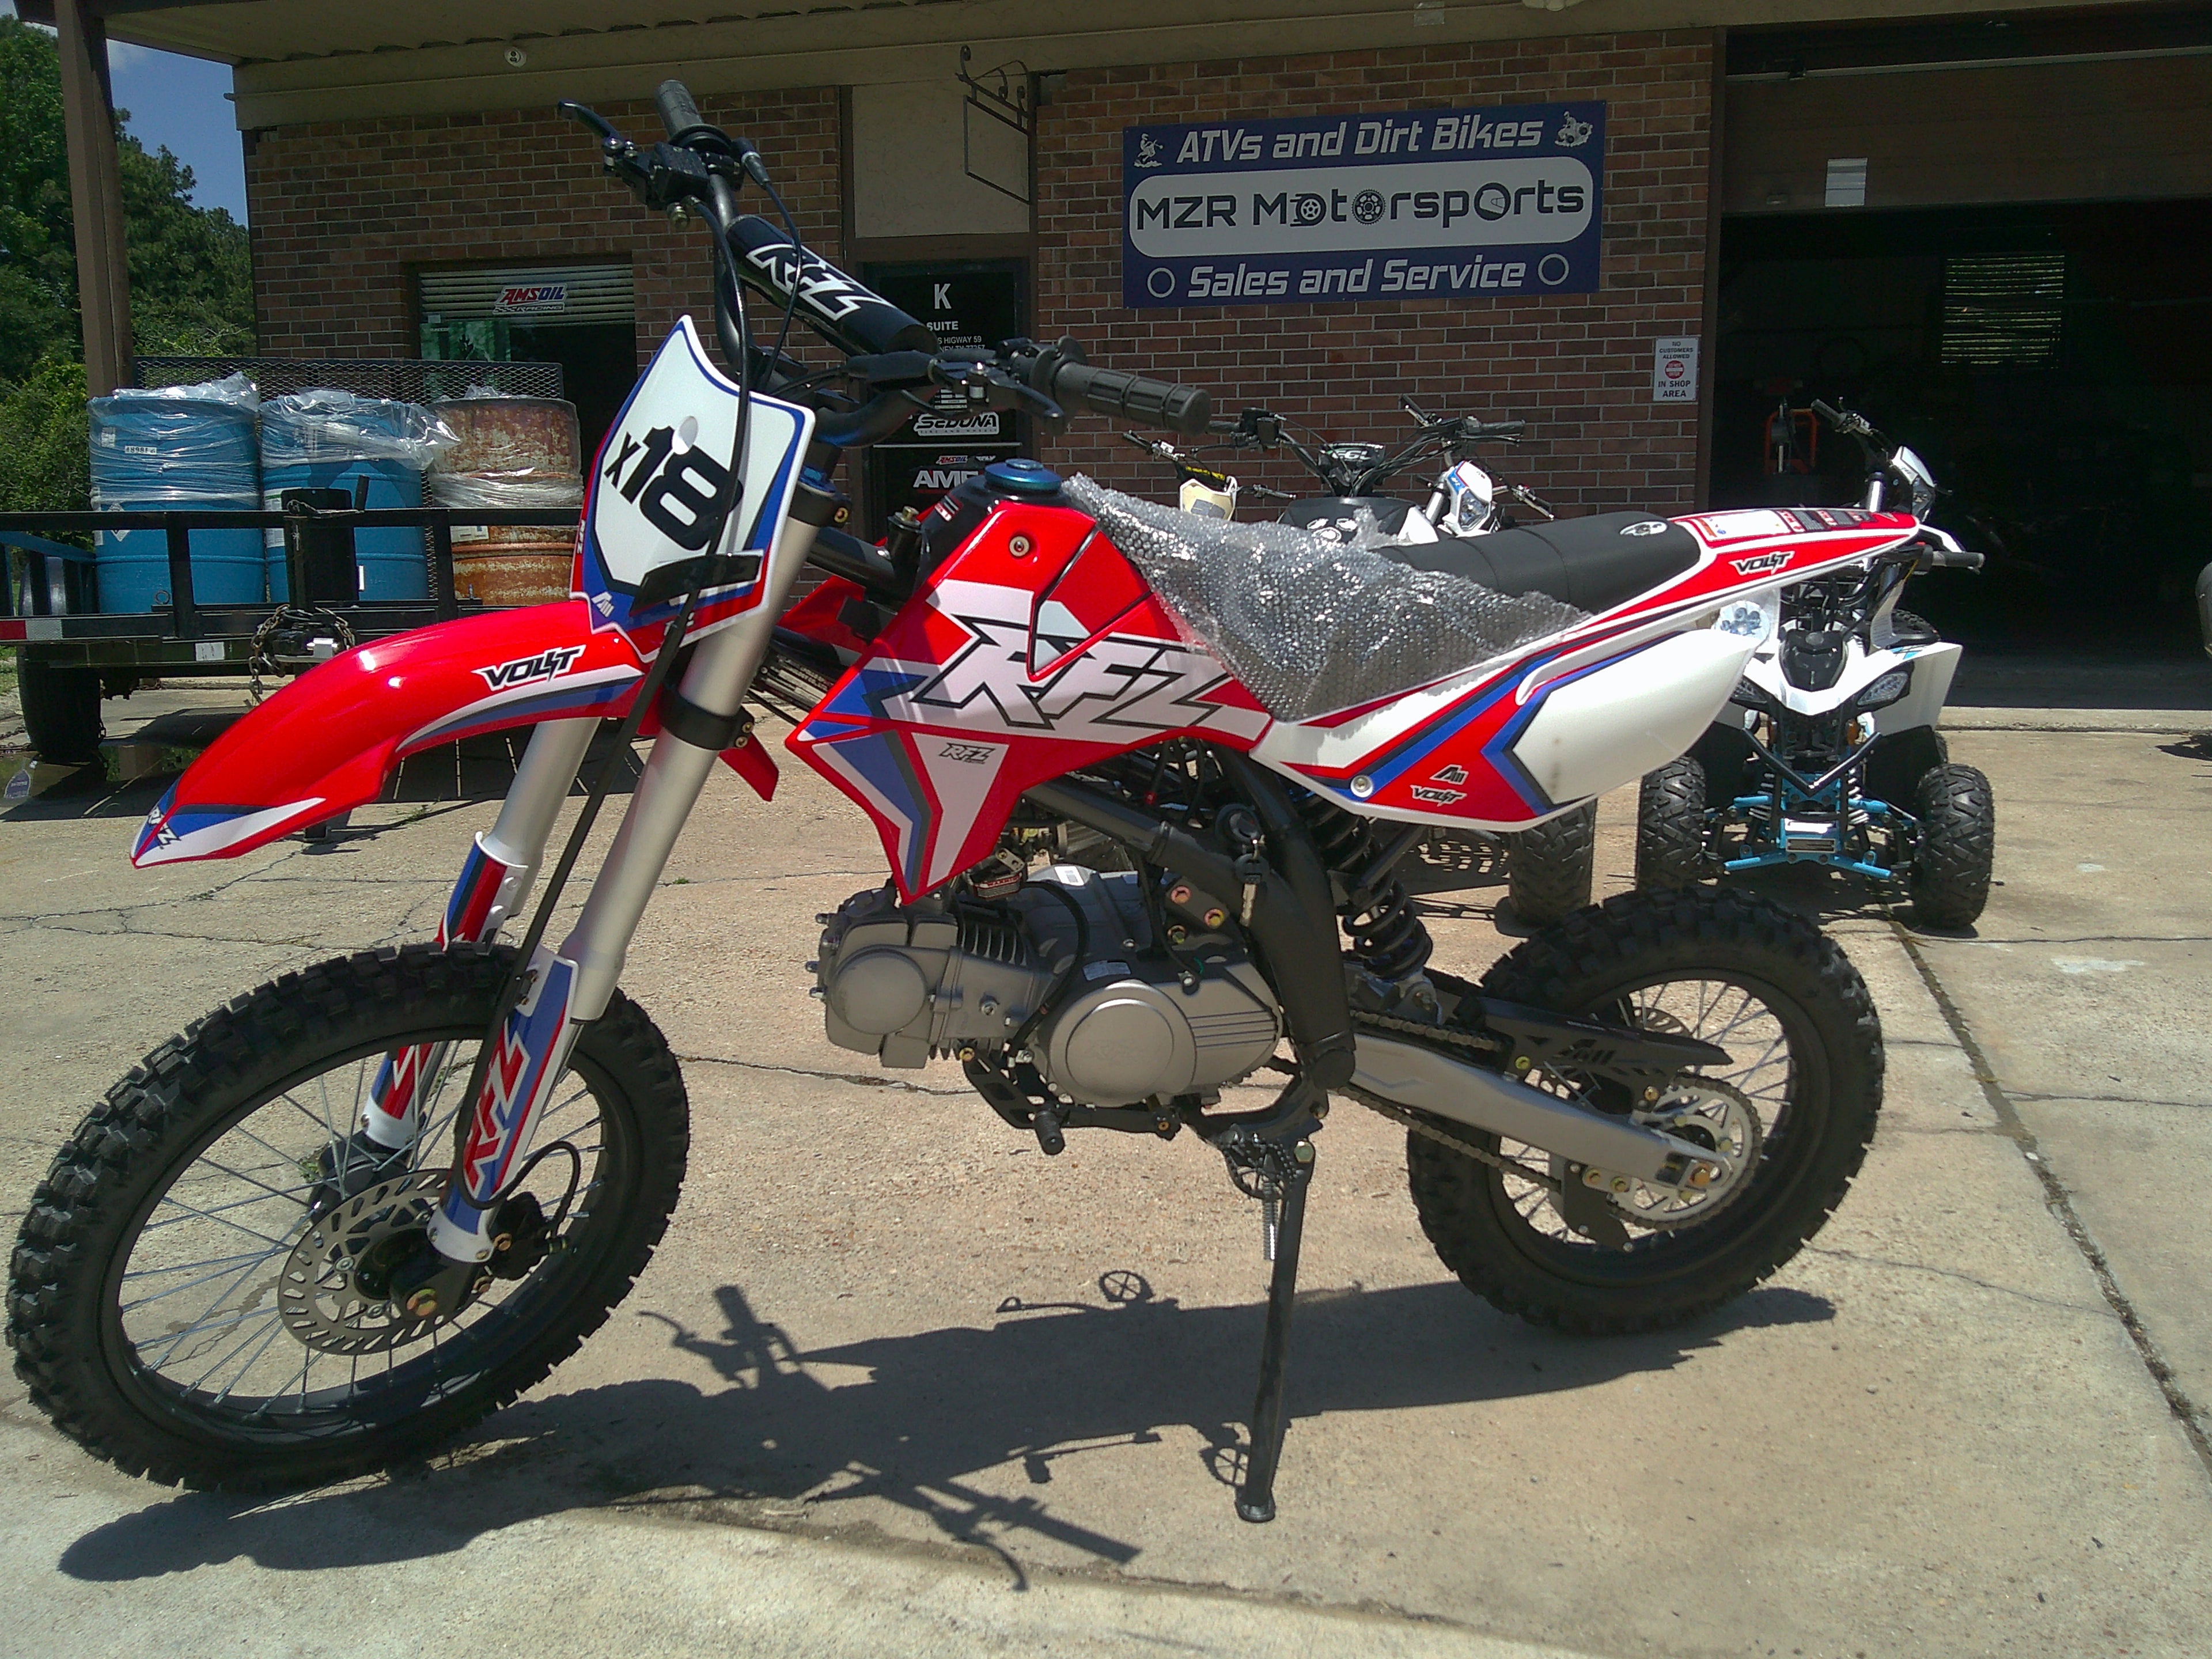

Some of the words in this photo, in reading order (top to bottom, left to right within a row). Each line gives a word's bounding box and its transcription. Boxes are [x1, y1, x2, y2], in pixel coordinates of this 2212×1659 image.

[1176, 128, 1263, 165] ATVs
[1272, 122, 1347, 159] and
[1354, 117, 1425, 156] Dirt
[1432, 113, 1544, 151] Bikes
[1137, 195, 1236, 230] MZR
[1253, 179, 1585, 229] Motorsports
[1187, 262, 1290, 298] Sales
[1299, 259, 1375, 295] and
[1381, 254, 1527, 291] Service
[499, 286, 566, 305] AMSOIL
[934, 283, 952, 309] K
[926, 321, 959, 331] SUITE
[944, 336, 972, 344] HIGWAY
[1728, 550, 1796, 577] VOLT
[476, 646, 584, 690] VOLT
